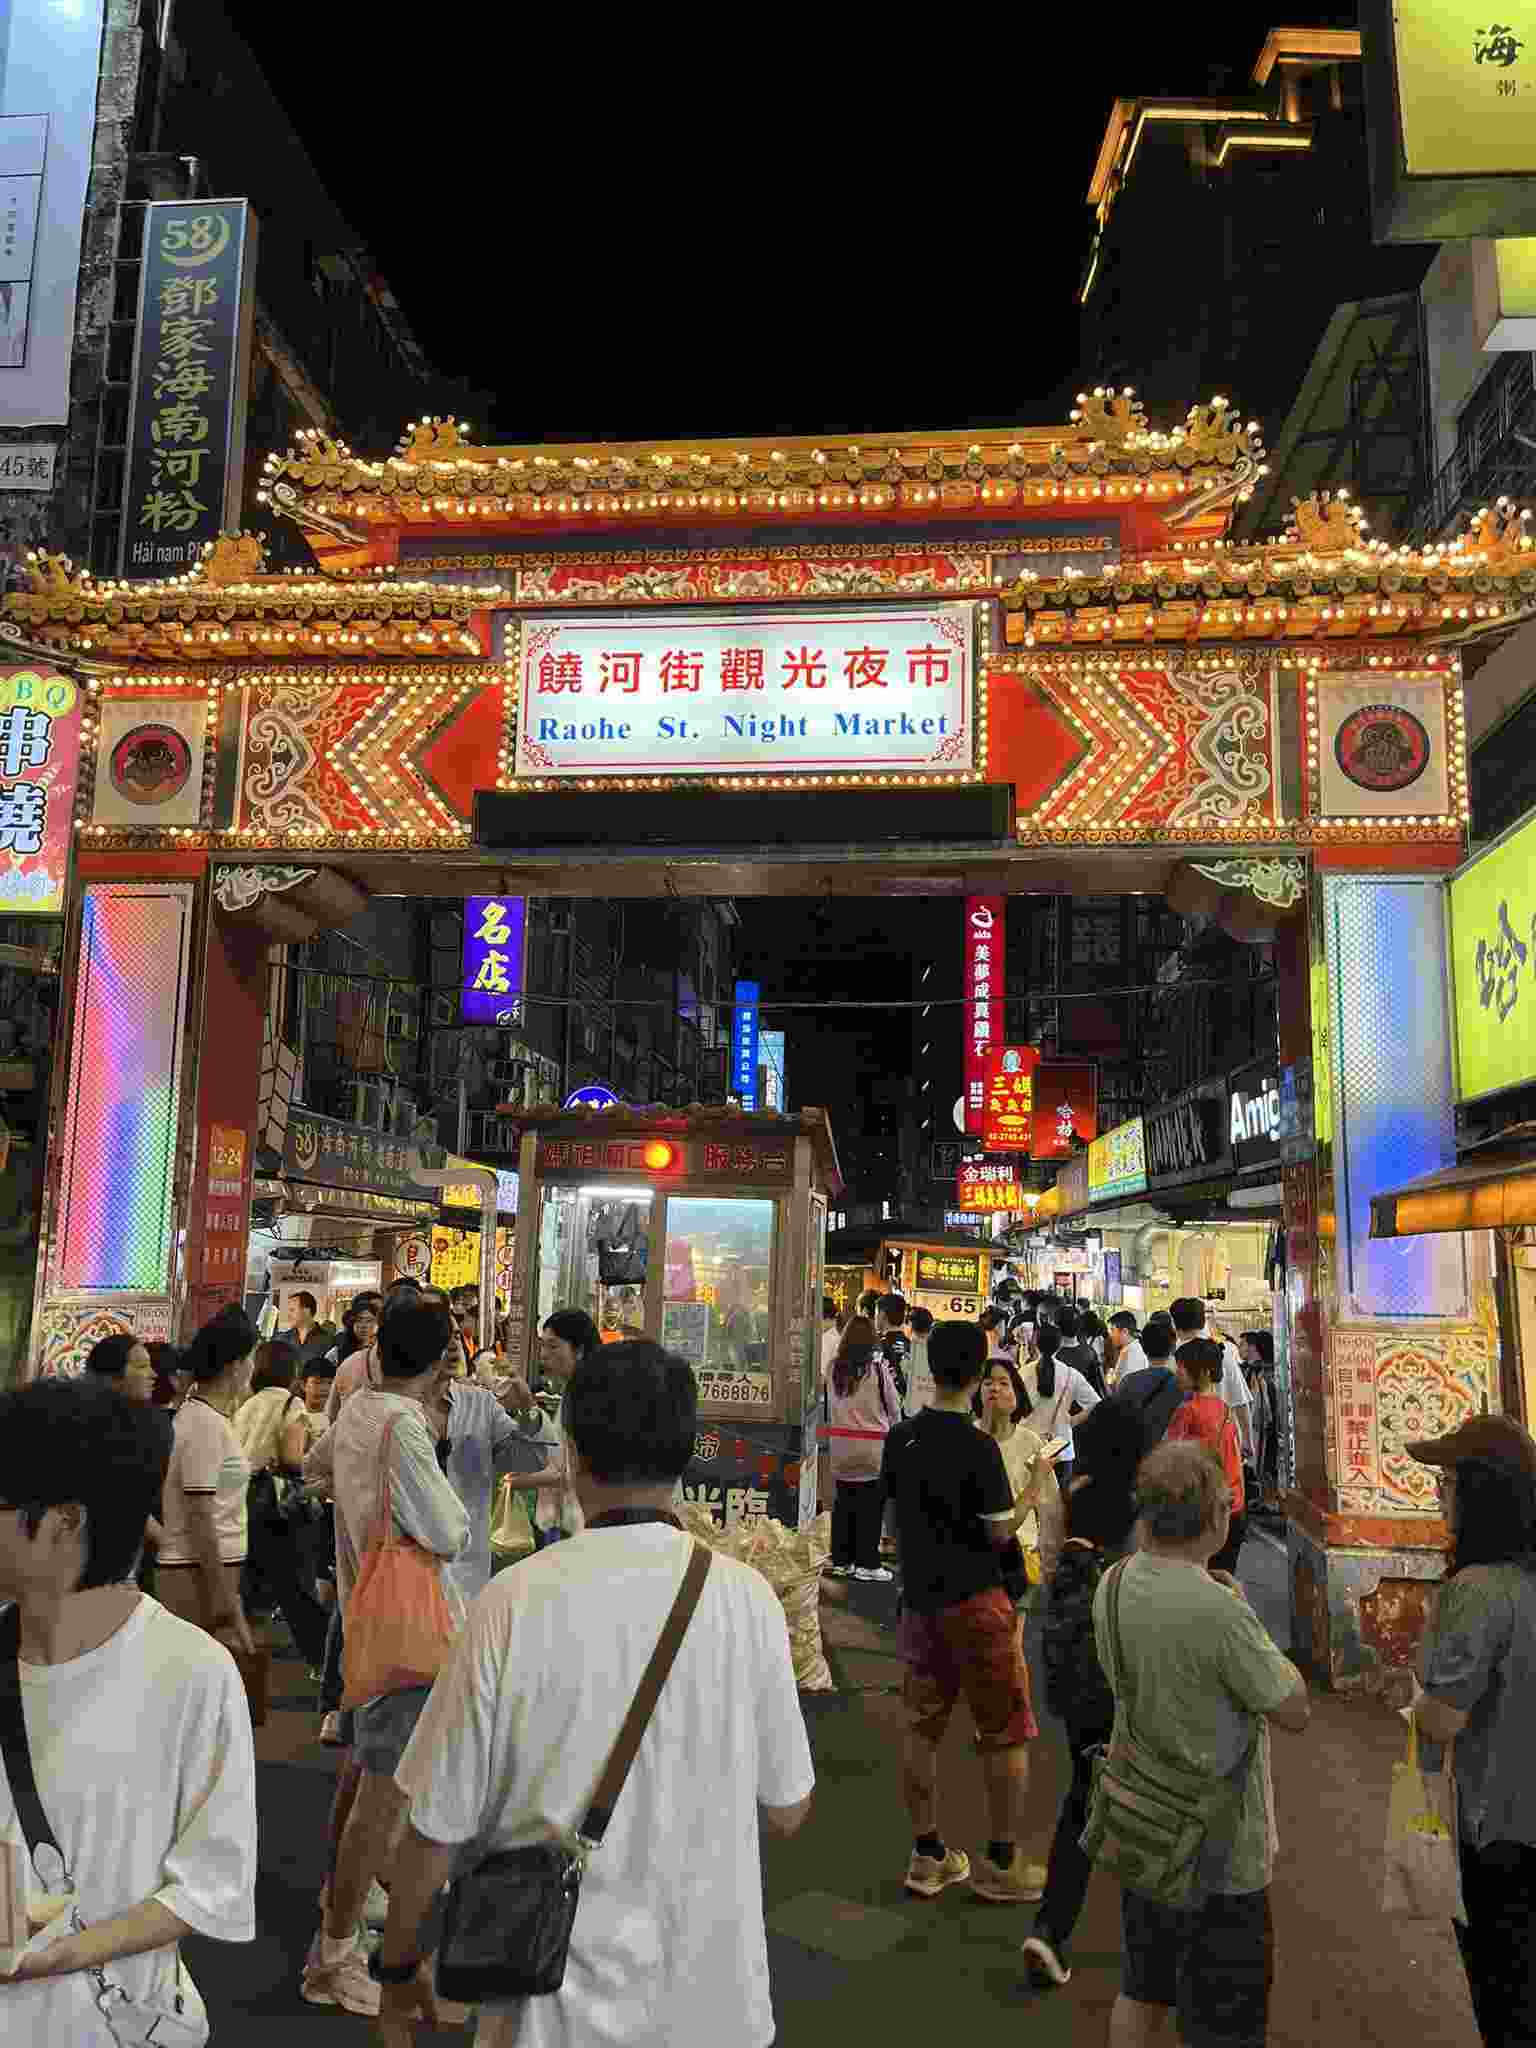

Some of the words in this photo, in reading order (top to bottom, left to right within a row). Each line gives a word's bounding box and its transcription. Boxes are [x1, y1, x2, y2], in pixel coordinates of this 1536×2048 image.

[1473, 24, 1524, 67] 海
[161, 217, 216, 250] 58
[141, 277, 219, 533] 鄧家海南河粉
[157, 546, 184, 562] nam
[536, 642, 953, 695] 饒河街觀光夜市
[537, 716, 632, 741] Raohe
[656, 717, 700, 739] St.
[722, 713, 808, 743] Night
[833, 711, 949, 736] Market
[473, 901, 512, 994] 名店
[1229, 1078, 1282, 1145] Amig
[963, 1165, 1013, 1184] 金瑞利
[1344, 1417, 1371, 1482] 禁止進入
